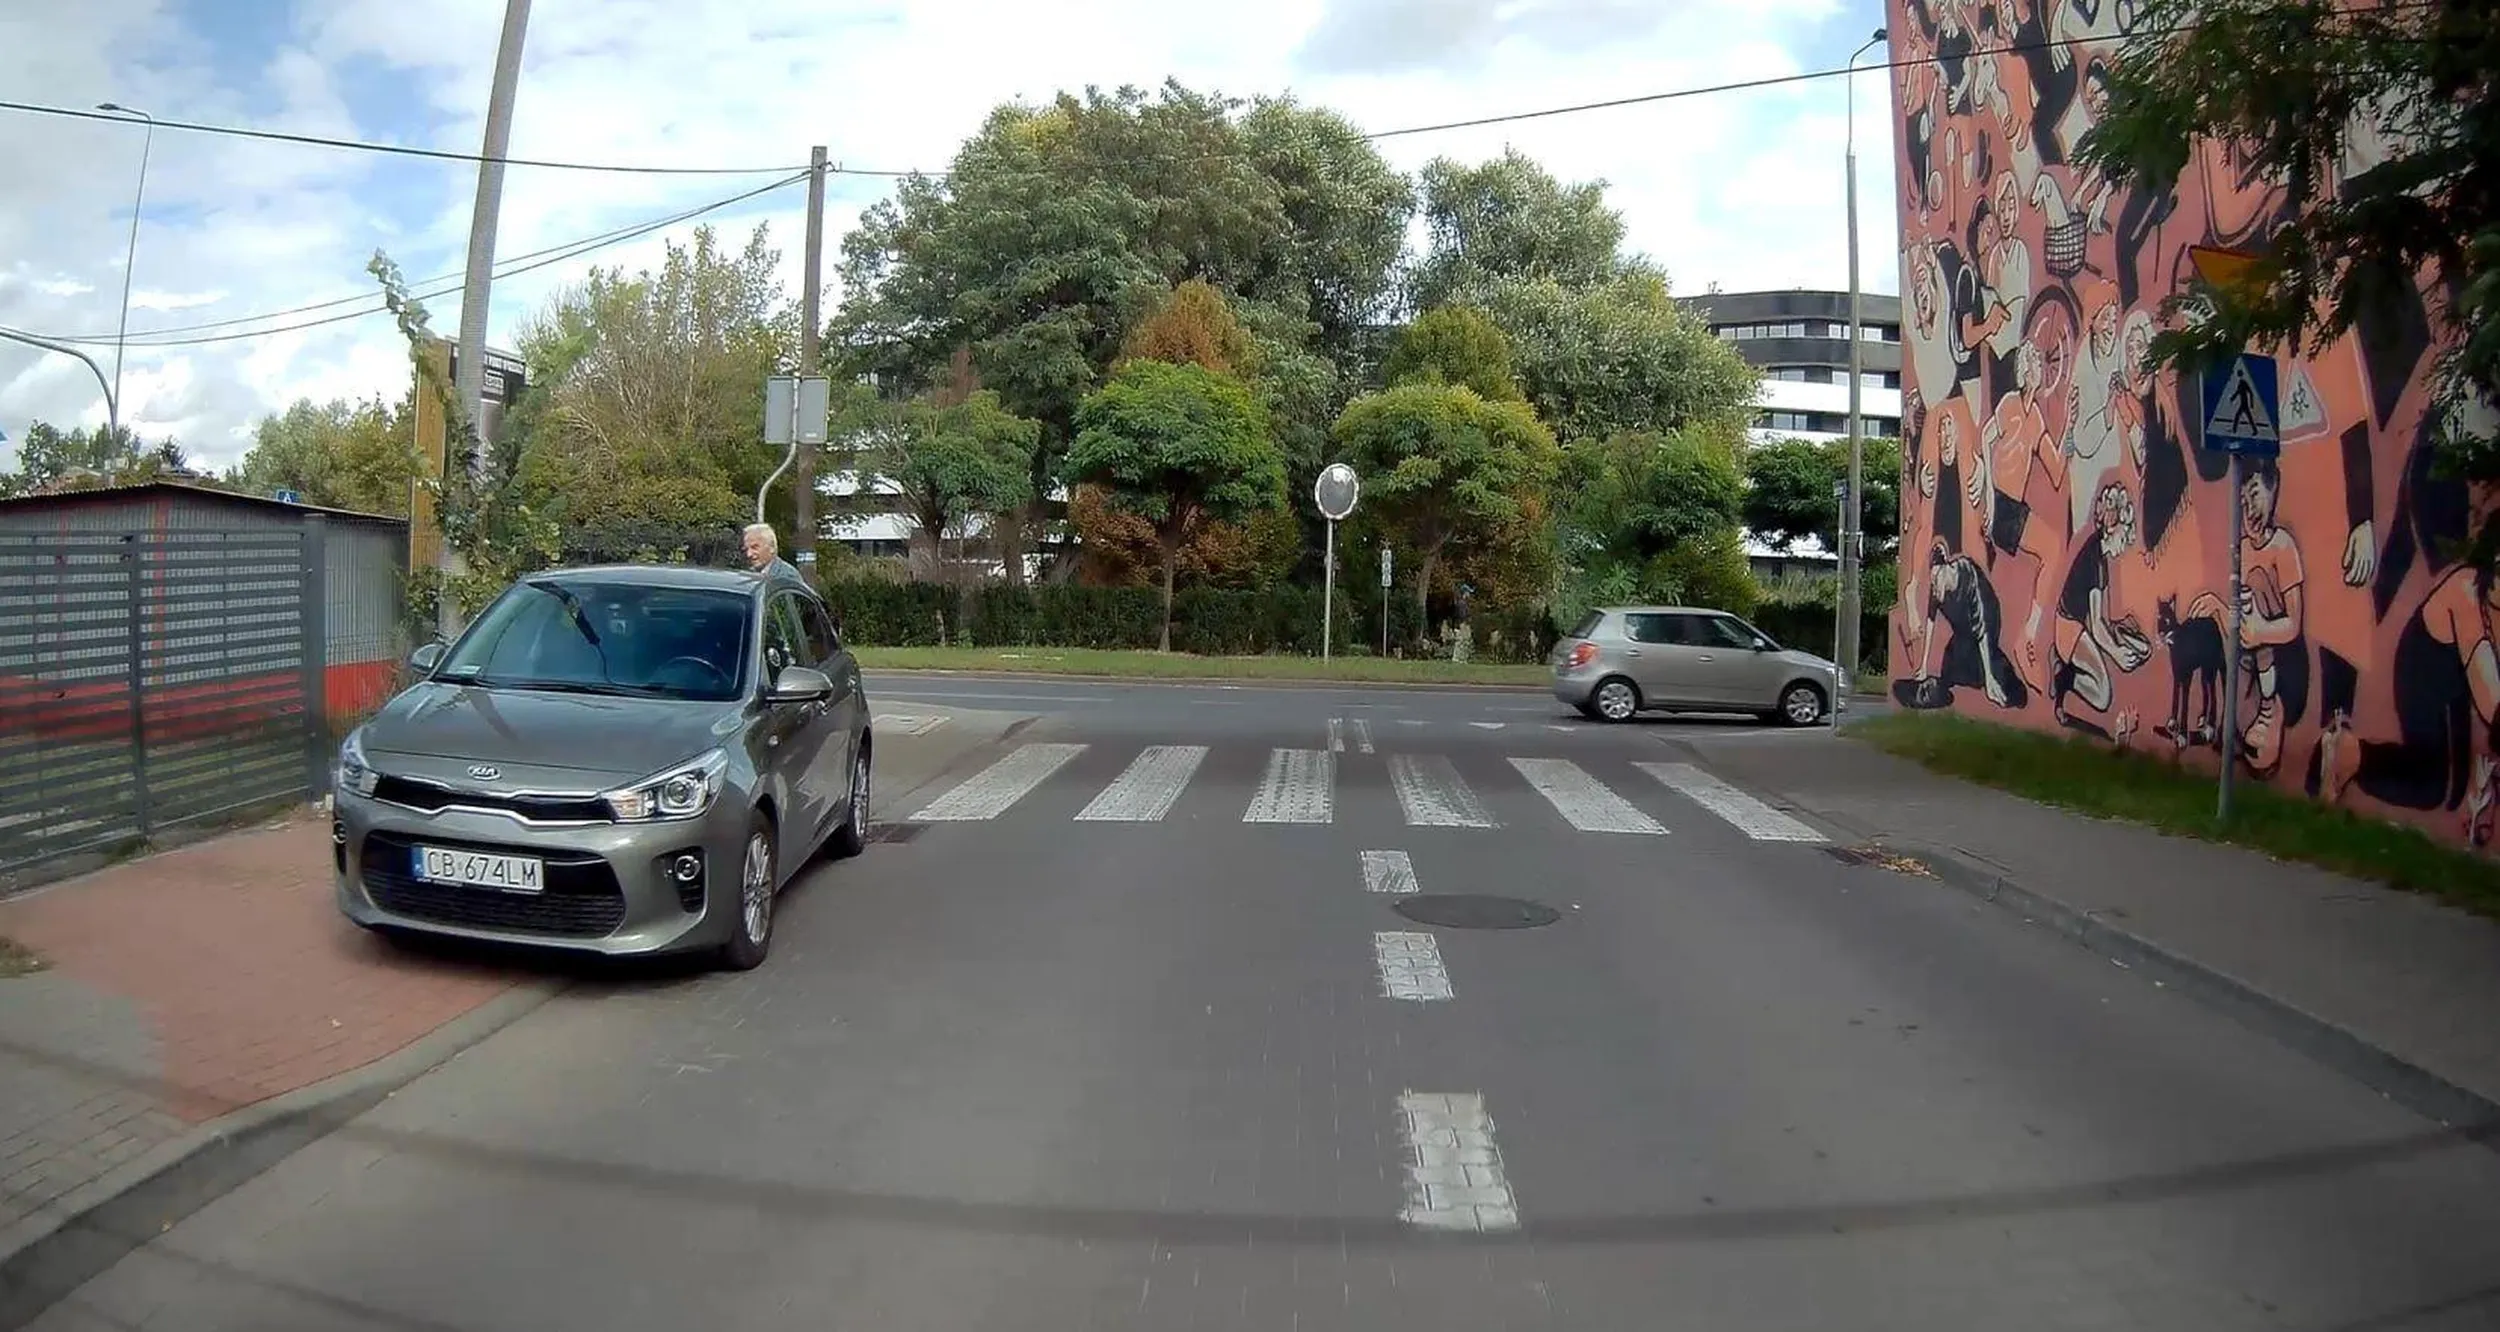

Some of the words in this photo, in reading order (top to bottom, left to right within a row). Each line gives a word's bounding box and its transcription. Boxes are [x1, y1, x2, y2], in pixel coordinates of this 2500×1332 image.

[470, 766, 498, 777] KIA
[427, 851, 455, 877] CB
[464, 856, 536, 886] 674LM
